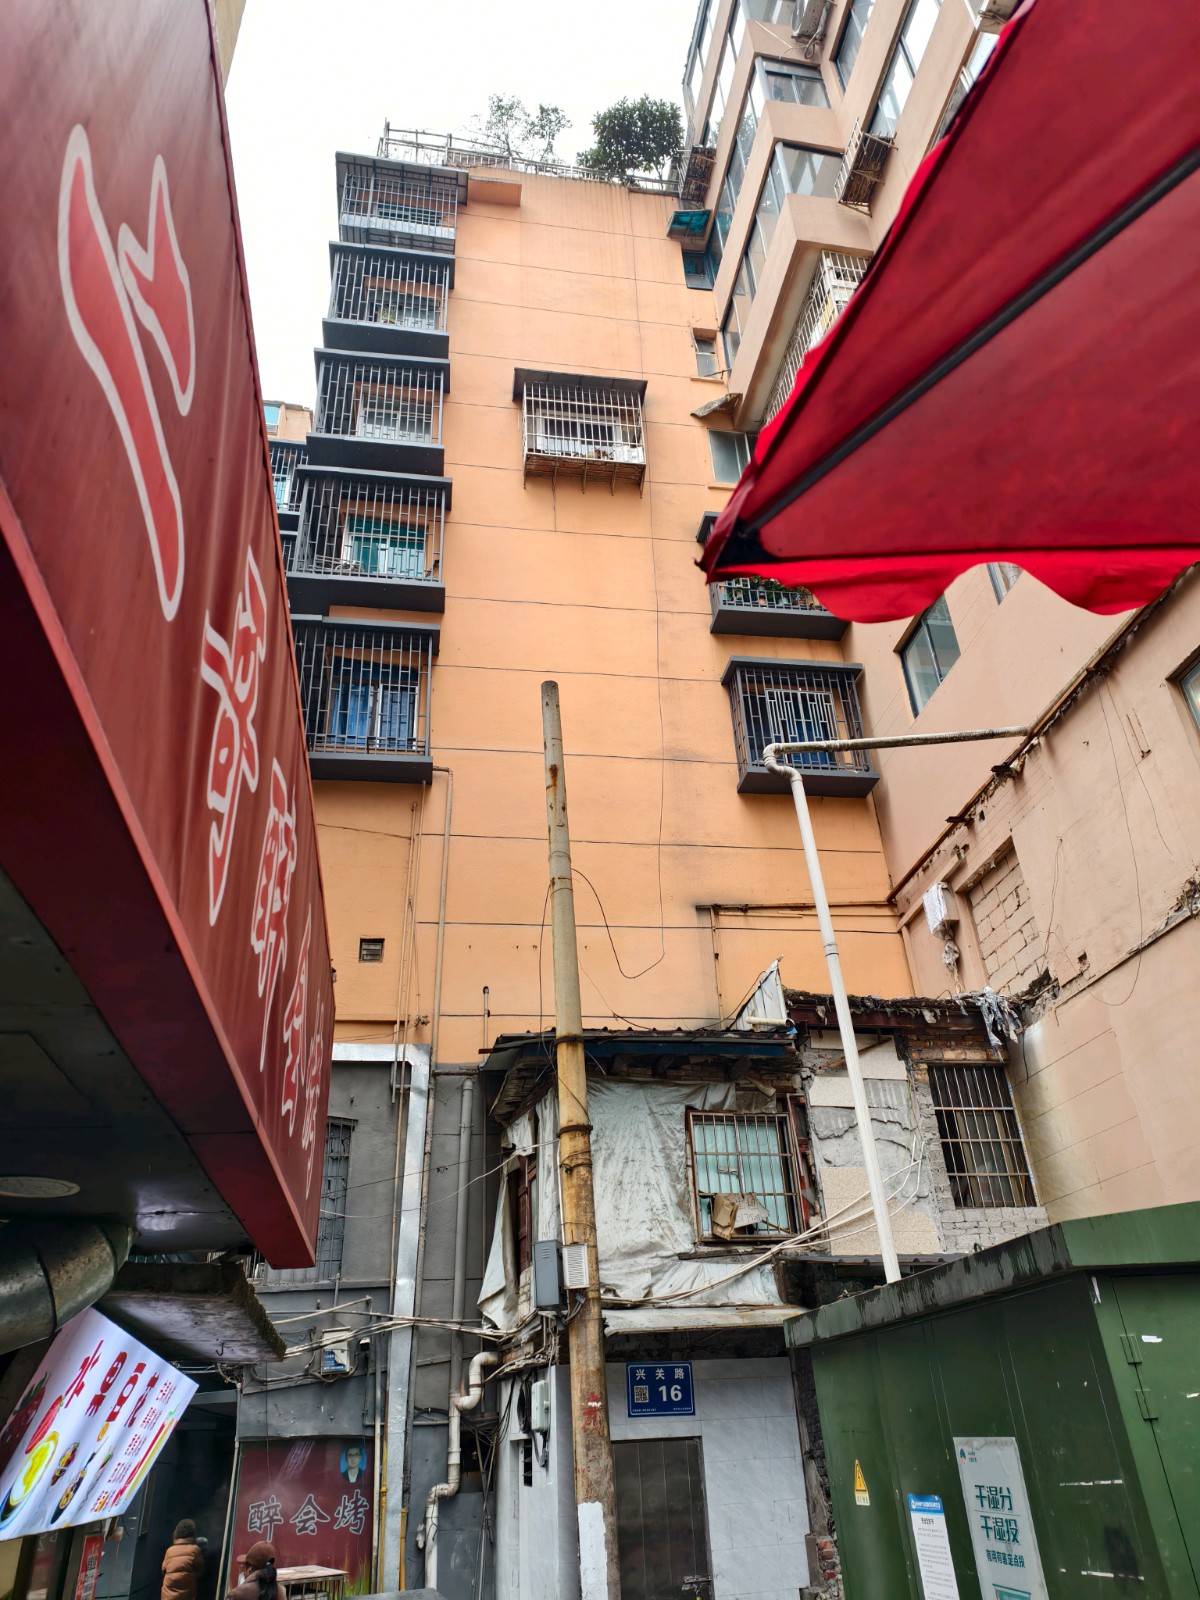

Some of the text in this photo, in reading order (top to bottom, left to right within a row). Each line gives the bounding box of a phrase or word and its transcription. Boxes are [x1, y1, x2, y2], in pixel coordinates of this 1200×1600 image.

[64, 1340, 160, 1428] 水果豆花
[635, 1367, 685, 1381] 兴关路
[658, 1384, 683, 1402] 16
[974, 1484, 1013, 1511] 干湿分
[247, 1489, 370, 1543] 醉会烤
[979, 1515, 1020, 1543] 干湿投
